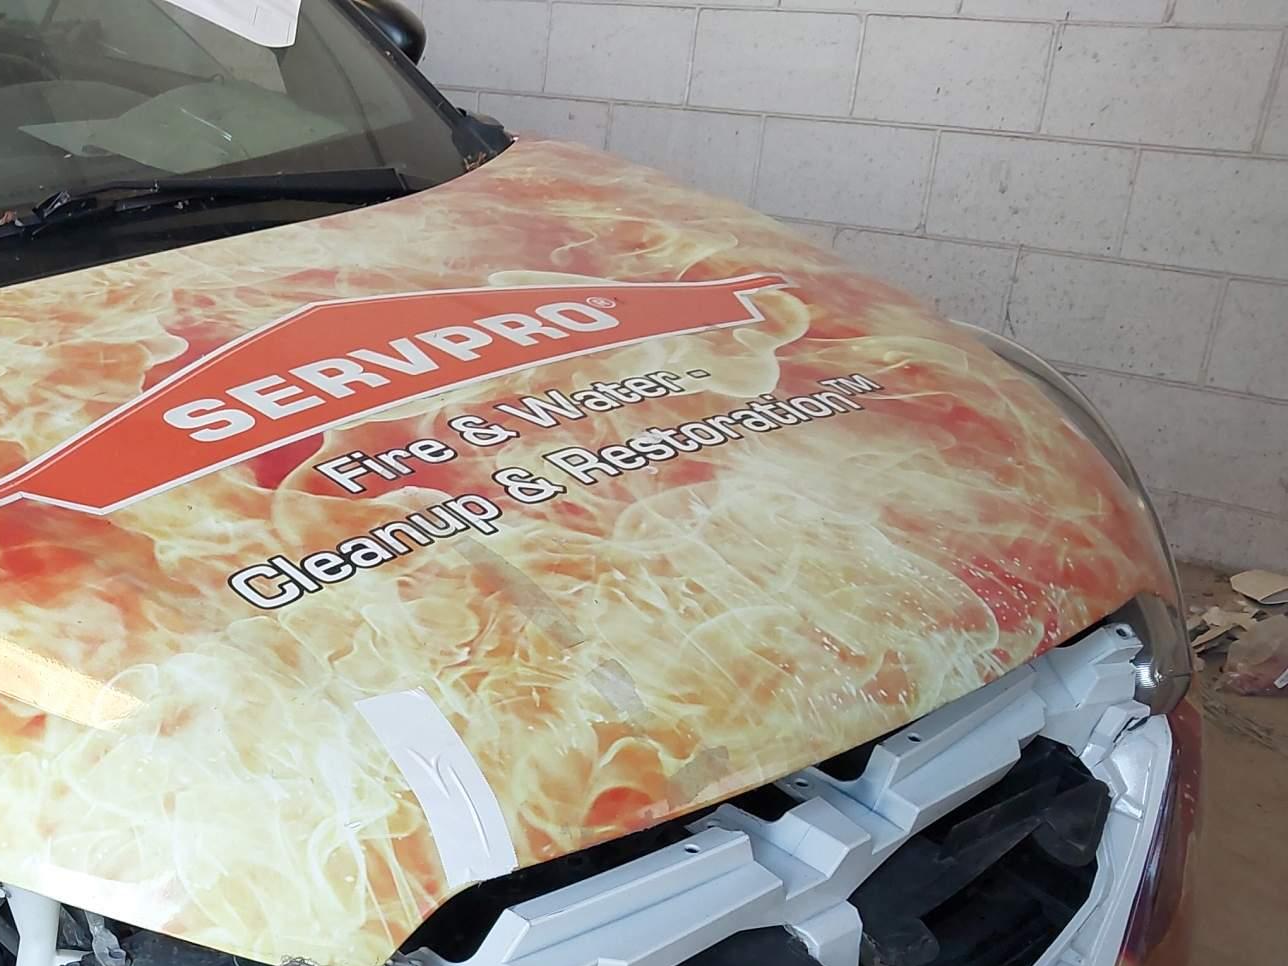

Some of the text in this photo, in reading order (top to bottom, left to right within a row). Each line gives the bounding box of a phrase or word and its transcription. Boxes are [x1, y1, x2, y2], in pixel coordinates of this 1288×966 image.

[314, 437, 457, 495] Fire
[448, 412, 519, 448] &
[498, 366, 684, 430] Water
[227, 490, 502, 611] Cleanup
[492, 465, 567, 505] &
